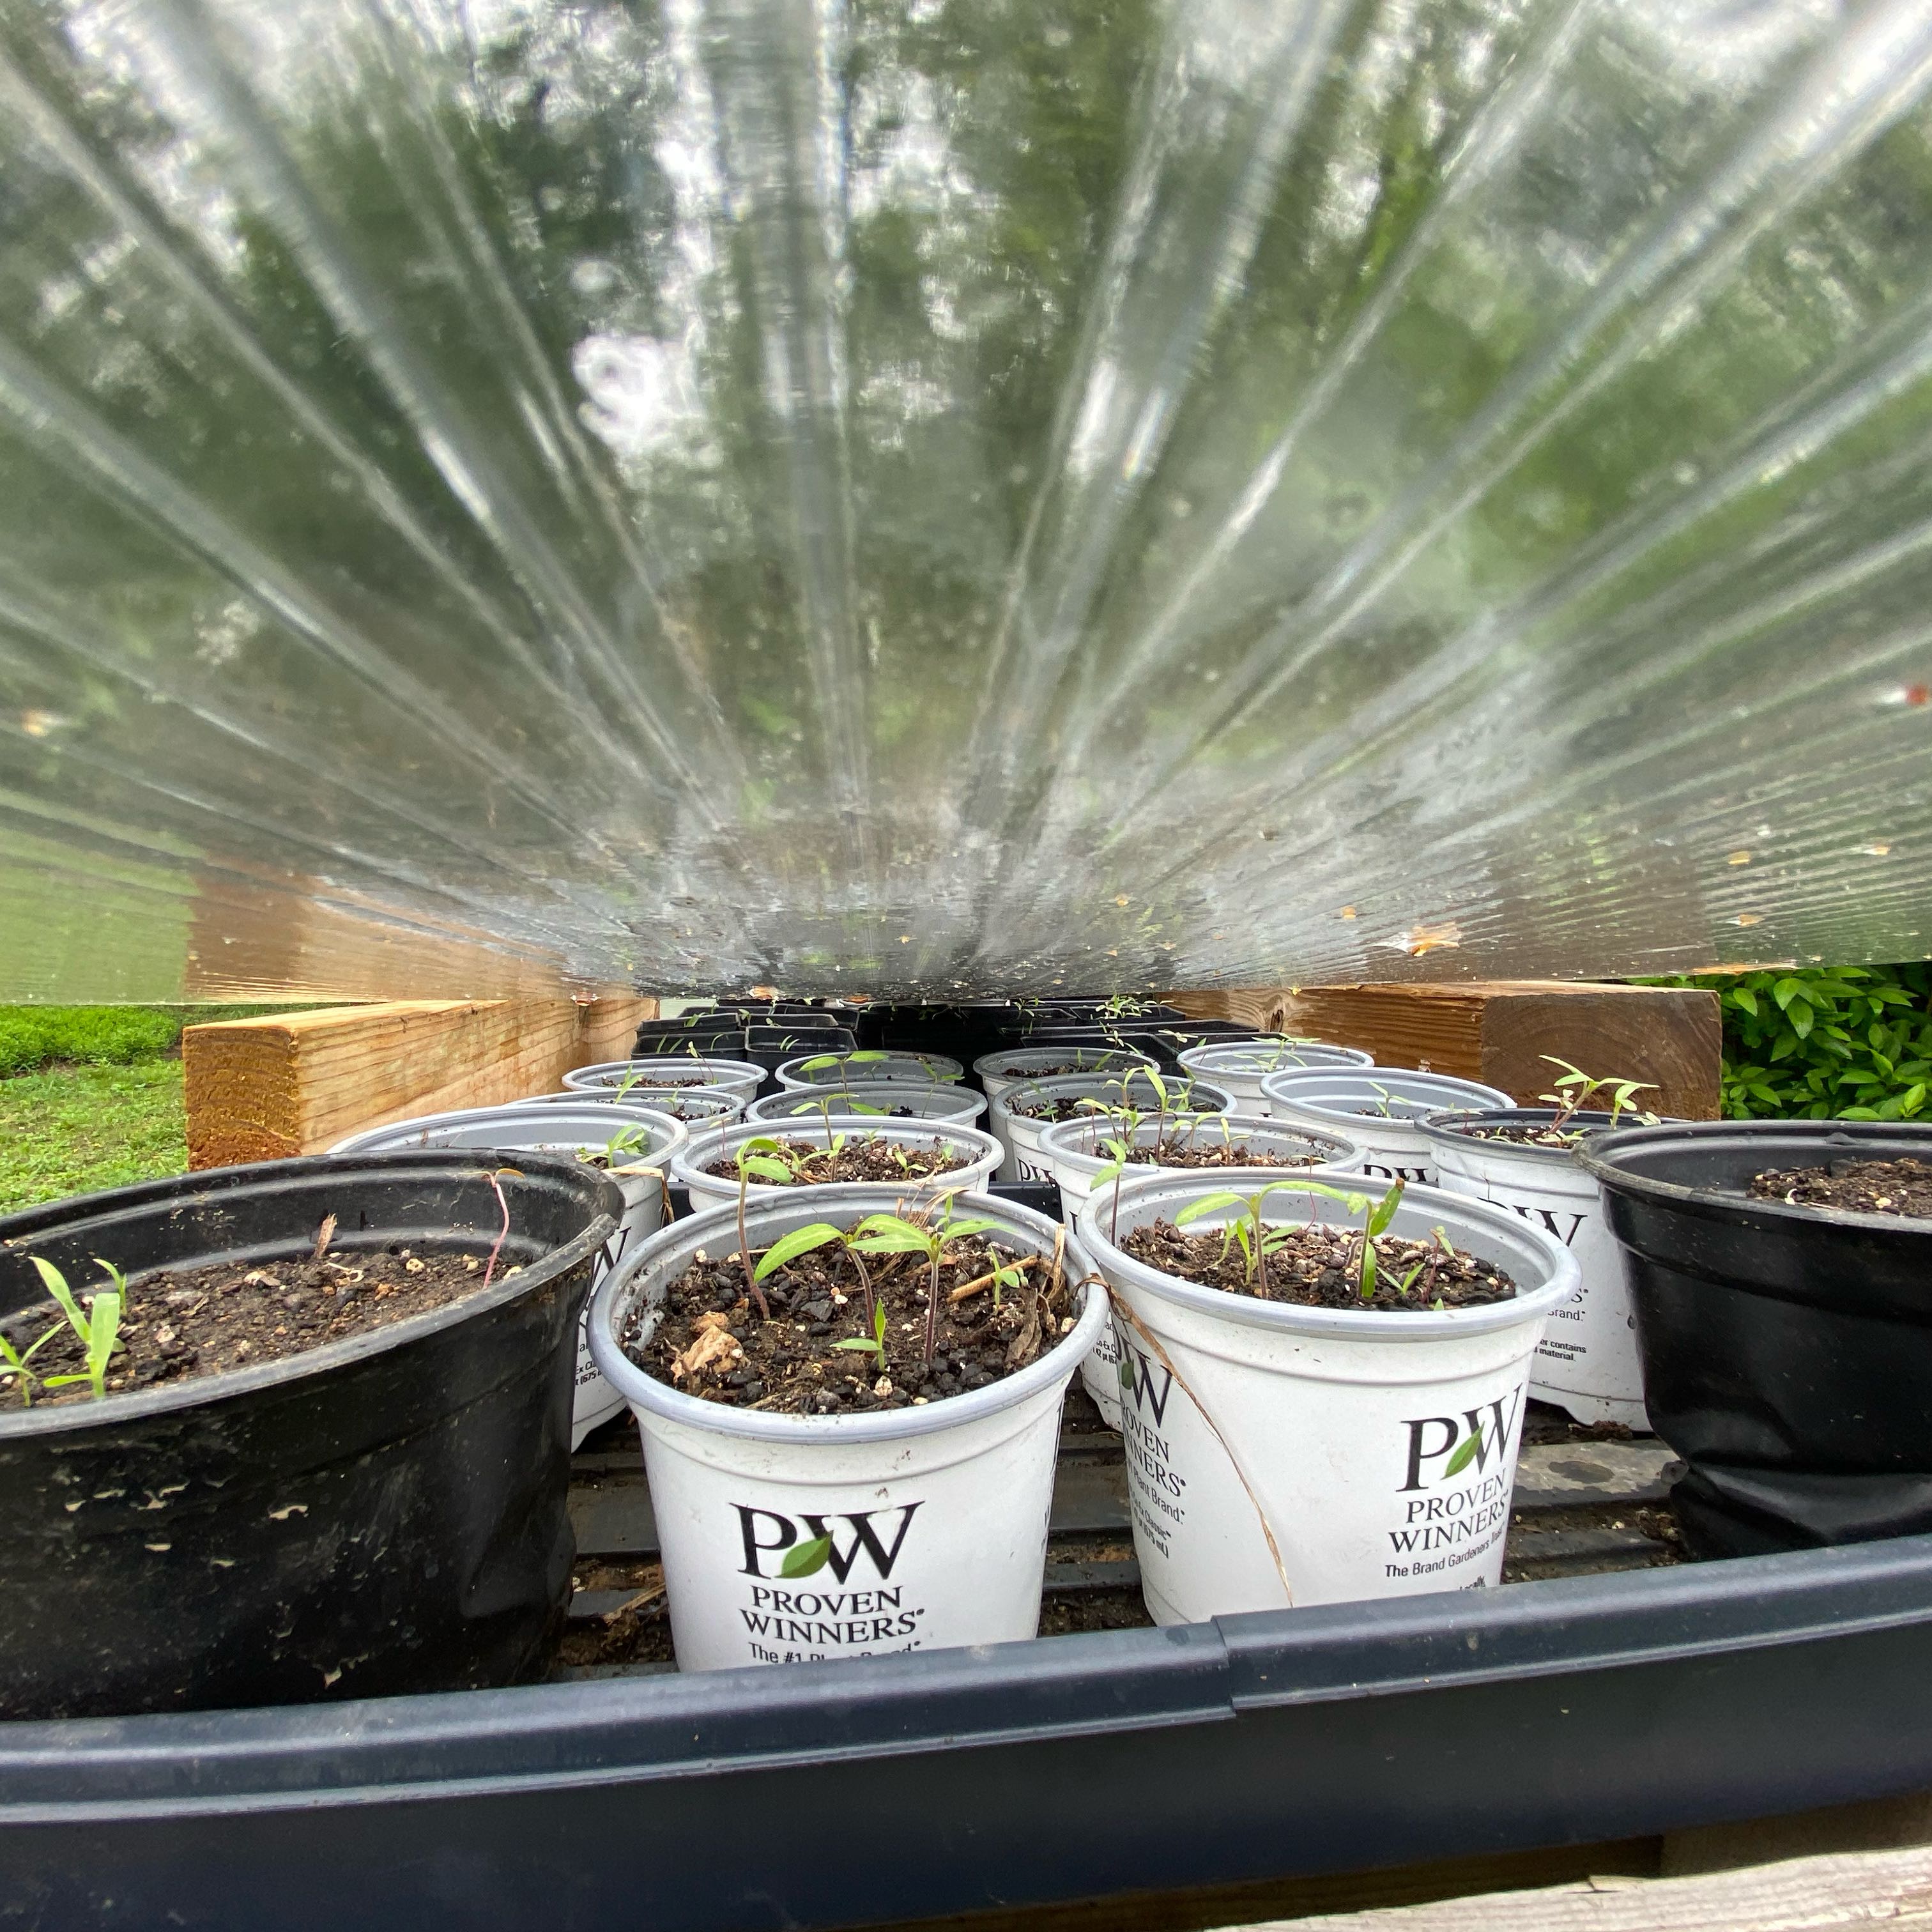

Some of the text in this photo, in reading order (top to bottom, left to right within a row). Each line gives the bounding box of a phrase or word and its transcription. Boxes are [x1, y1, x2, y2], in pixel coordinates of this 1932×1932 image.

[1550, 1340, 1587, 1353] contains
[1396, 1383, 1522, 1492] PW
[1406, 1468, 1506, 1524] PROVEN
[729, 1500, 925, 1584] PW
[1388, 1493, 1506, 1553] WINNERS
[1385, 1564, 1409, 1577] The
[1413, 1557, 1446, 1575] Brand
[1448, 1539, 1490, 1567] Gardeners
[749, 1585, 903, 1616] PROVEN
[739, 1608, 920, 1644] WINNERS
[748, 1641, 779, 1664] The
